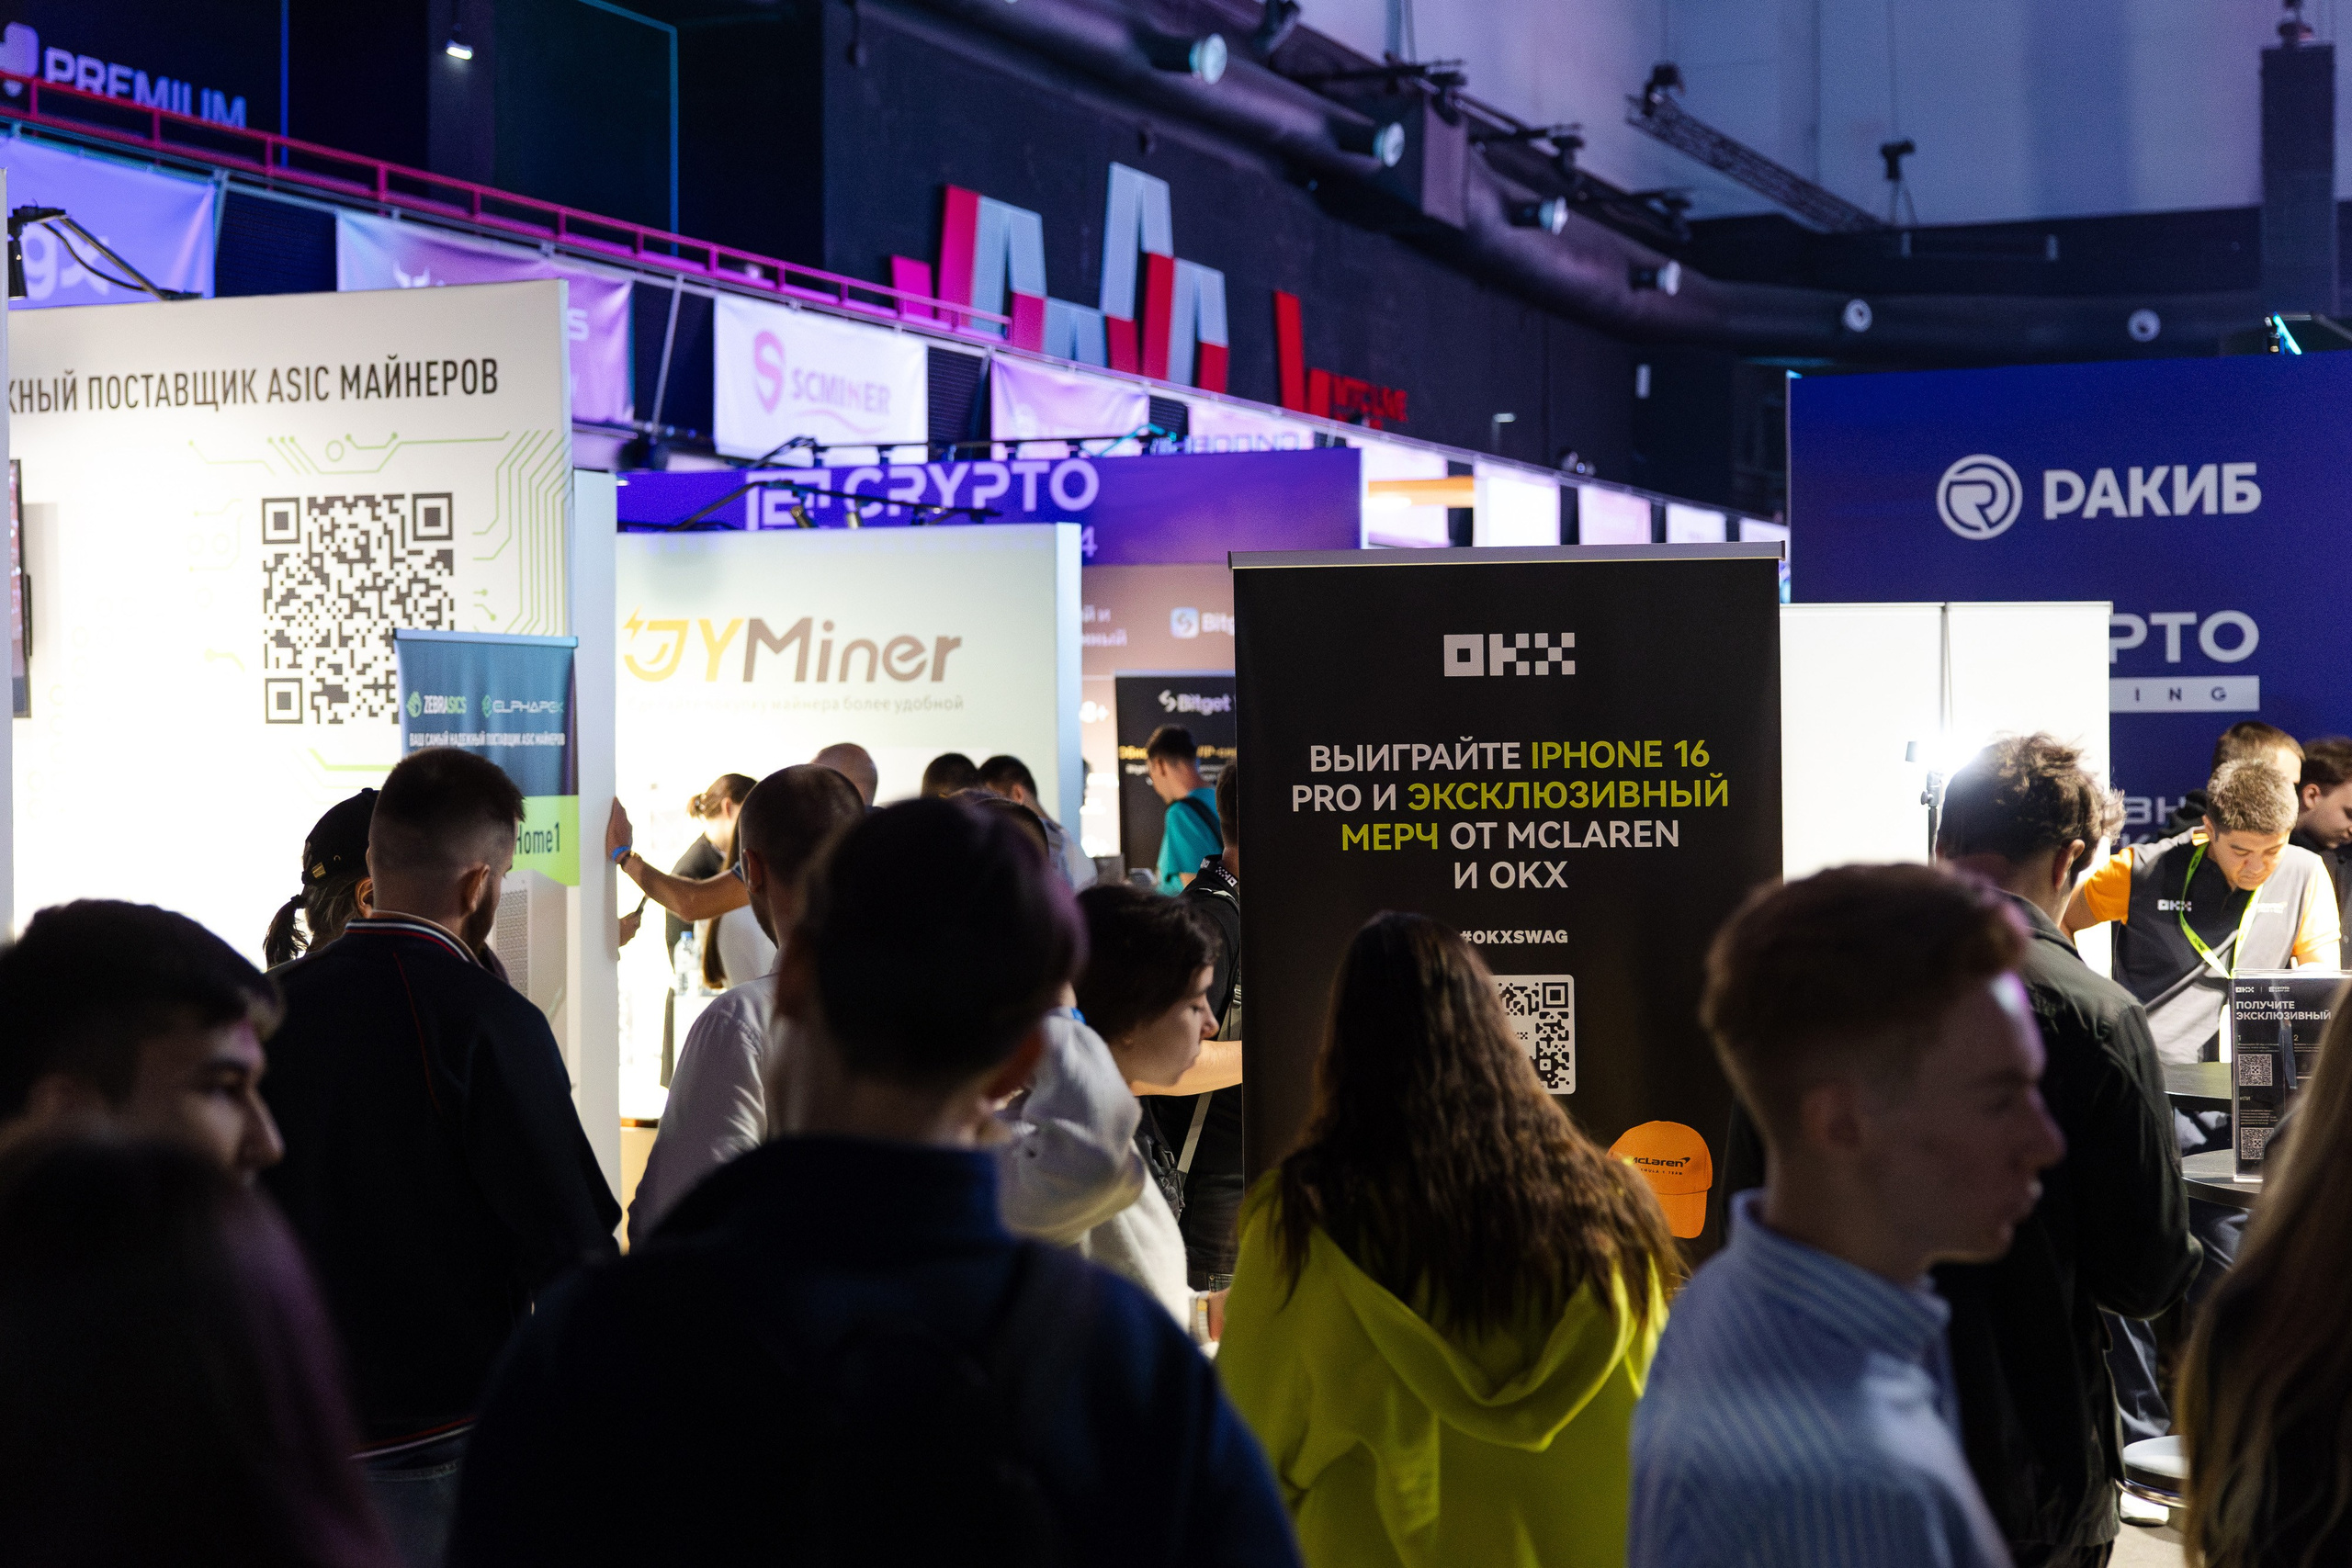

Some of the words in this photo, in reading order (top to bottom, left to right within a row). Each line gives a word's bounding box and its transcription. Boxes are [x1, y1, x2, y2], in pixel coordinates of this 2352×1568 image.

[44, 46, 247, 130] PREMIUM
[89, 370, 257, 412] ПОСТАВЩИК
[267, 367, 329, 404] ASIC
[341, 355, 498, 400] МАЙНЕРОВ
[792, 367, 891, 416] SCMINER
[842, 460, 1100, 518] CRYPTO
[2043, 461, 2262, 520] РАКИБ
[623, 615, 963, 682] JYMiner
[1443, 632, 1576, 677] OKX
[1310, 736, 1521, 772] ВЫИГРАЙТЕ
[1532, 740, 1663, 770] IPHONE
[1674, 739, 1711, 768] 16
[1292, 784, 1362, 812] PRO
[1373, 784, 1396, 811] И
[1408, 773, 1729, 810] ЭКСКЛЮЗИВНЫЙ
[1342, 823, 1439, 851] МЕРЧ
[1450, 821, 1498, 850] ОТ
[1508, 819, 1679, 850] MCLAREN
[1454, 862, 1477, 889] И
[1489, 861, 1568, 889] OKX
[2157, 899, 2192, 912] OKX
[2236, 1000, 2295, 1010] ПОЛУЧИТЕ
[2236, 1010, 2332, 1021] ЭКСКЛЮЗИВНЫЙ
